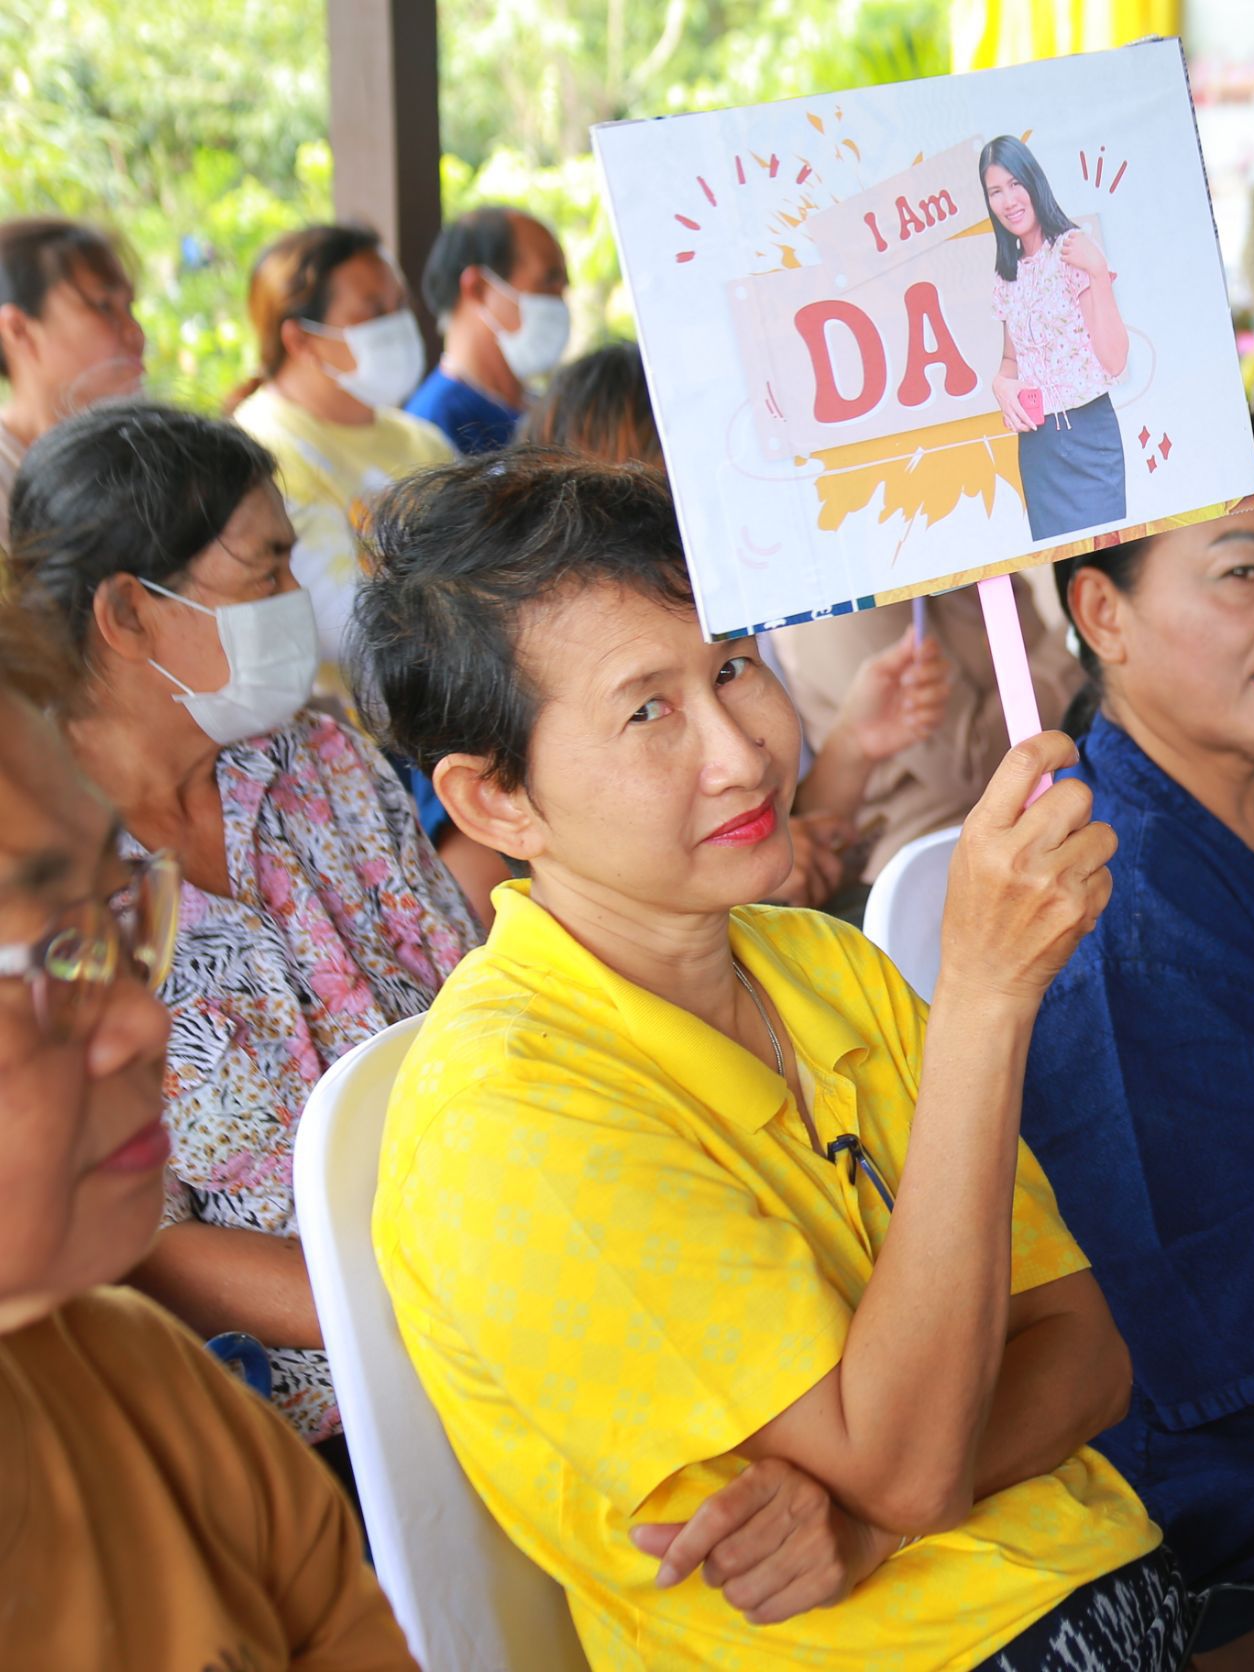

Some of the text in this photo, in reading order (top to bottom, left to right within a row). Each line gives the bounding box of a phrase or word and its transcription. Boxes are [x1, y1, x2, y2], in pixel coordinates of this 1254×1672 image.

[863, 189, 958, 253] I Am
[793, 281, 979, 424] DA
